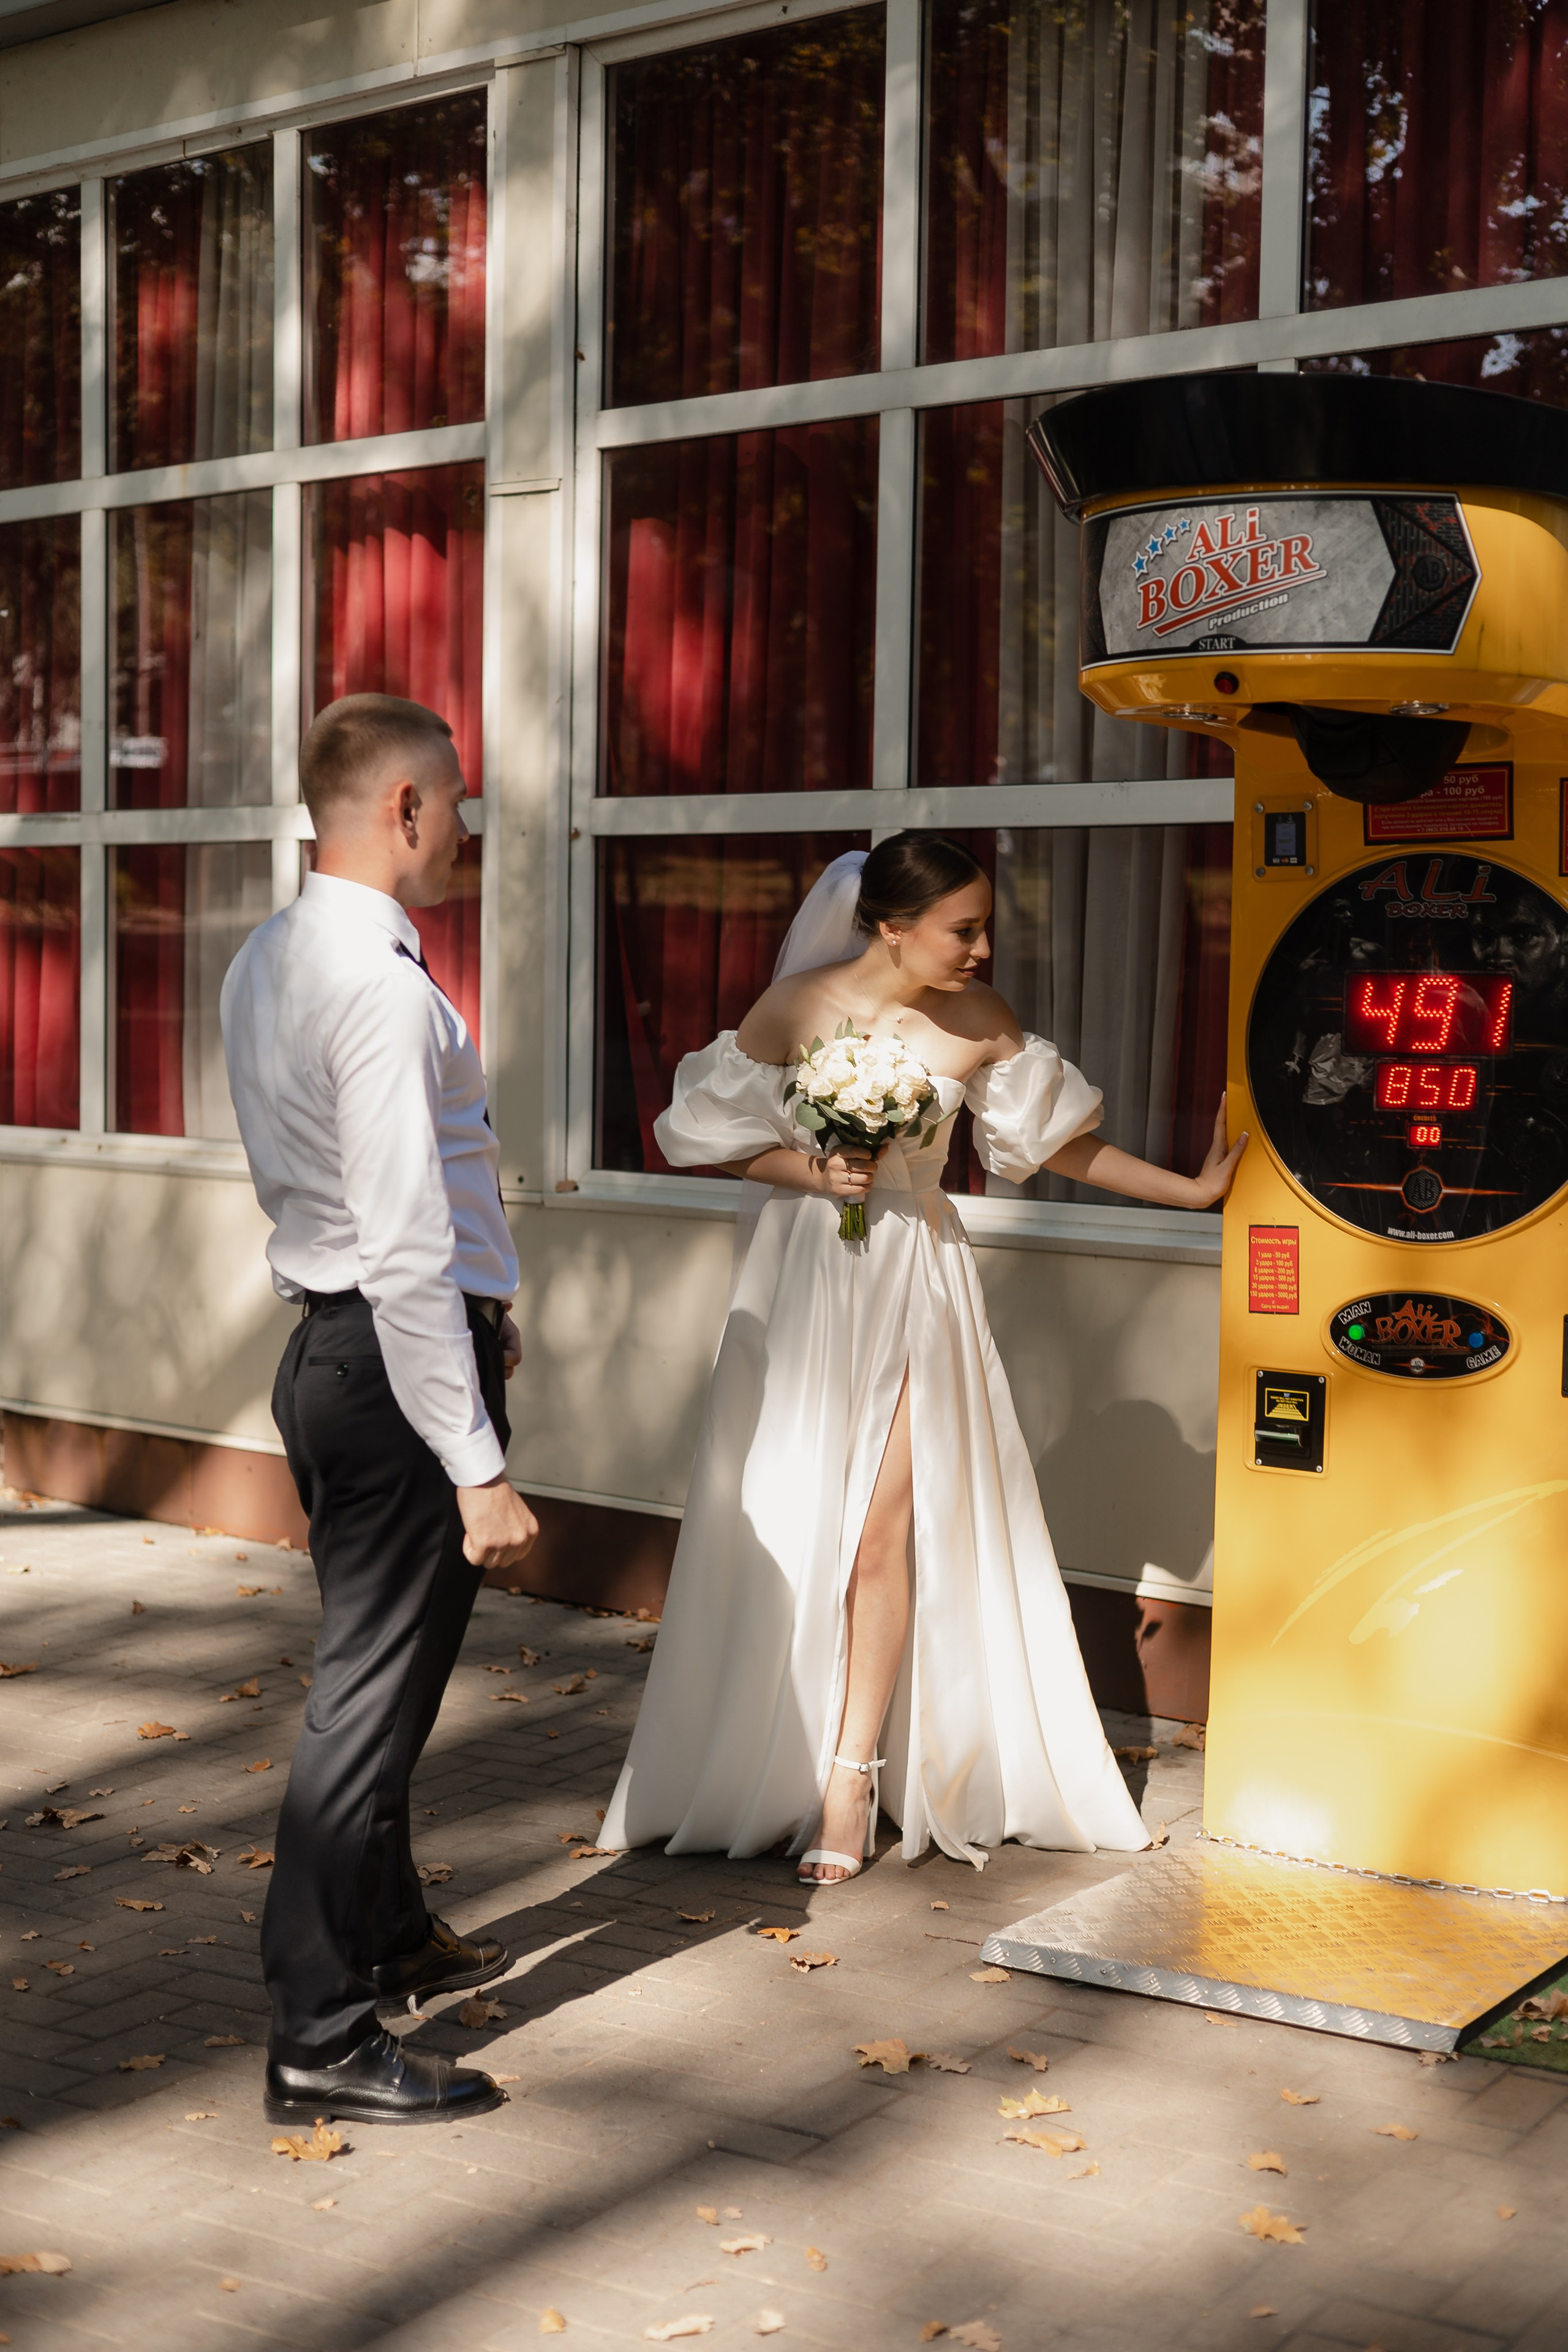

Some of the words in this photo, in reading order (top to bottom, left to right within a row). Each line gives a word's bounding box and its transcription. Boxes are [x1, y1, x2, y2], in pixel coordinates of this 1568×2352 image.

[1136, 533, 1320, 630] BOXER
[1198, 637, 1236, 650] START
[1443, 775, 1456, 784] 50
[1459, 774, 1479, 785] руб
[1443, 786, 1462, 796] 100
[1465, 785, 1485, 796] руб
[1385, 901, 1469, 920] BOXER
[1362, 977, 1513, 1050] 491
[1384, 1066, 1477, 1107] 850
[1415, 1126, 1441, 1143] 00
[1250, 1236, 1281, 1245] Стоимость
[1387, 1226, 1455, 1240] www.ali-boxer.com
[1338, 1300, 1372, 1325] MAN
[1373, 1316, 1470, 1350] BOXER
[1338, 1335, 1381, 1366] WOMAN
[1466, 1344, 1502, 1370] GAME
